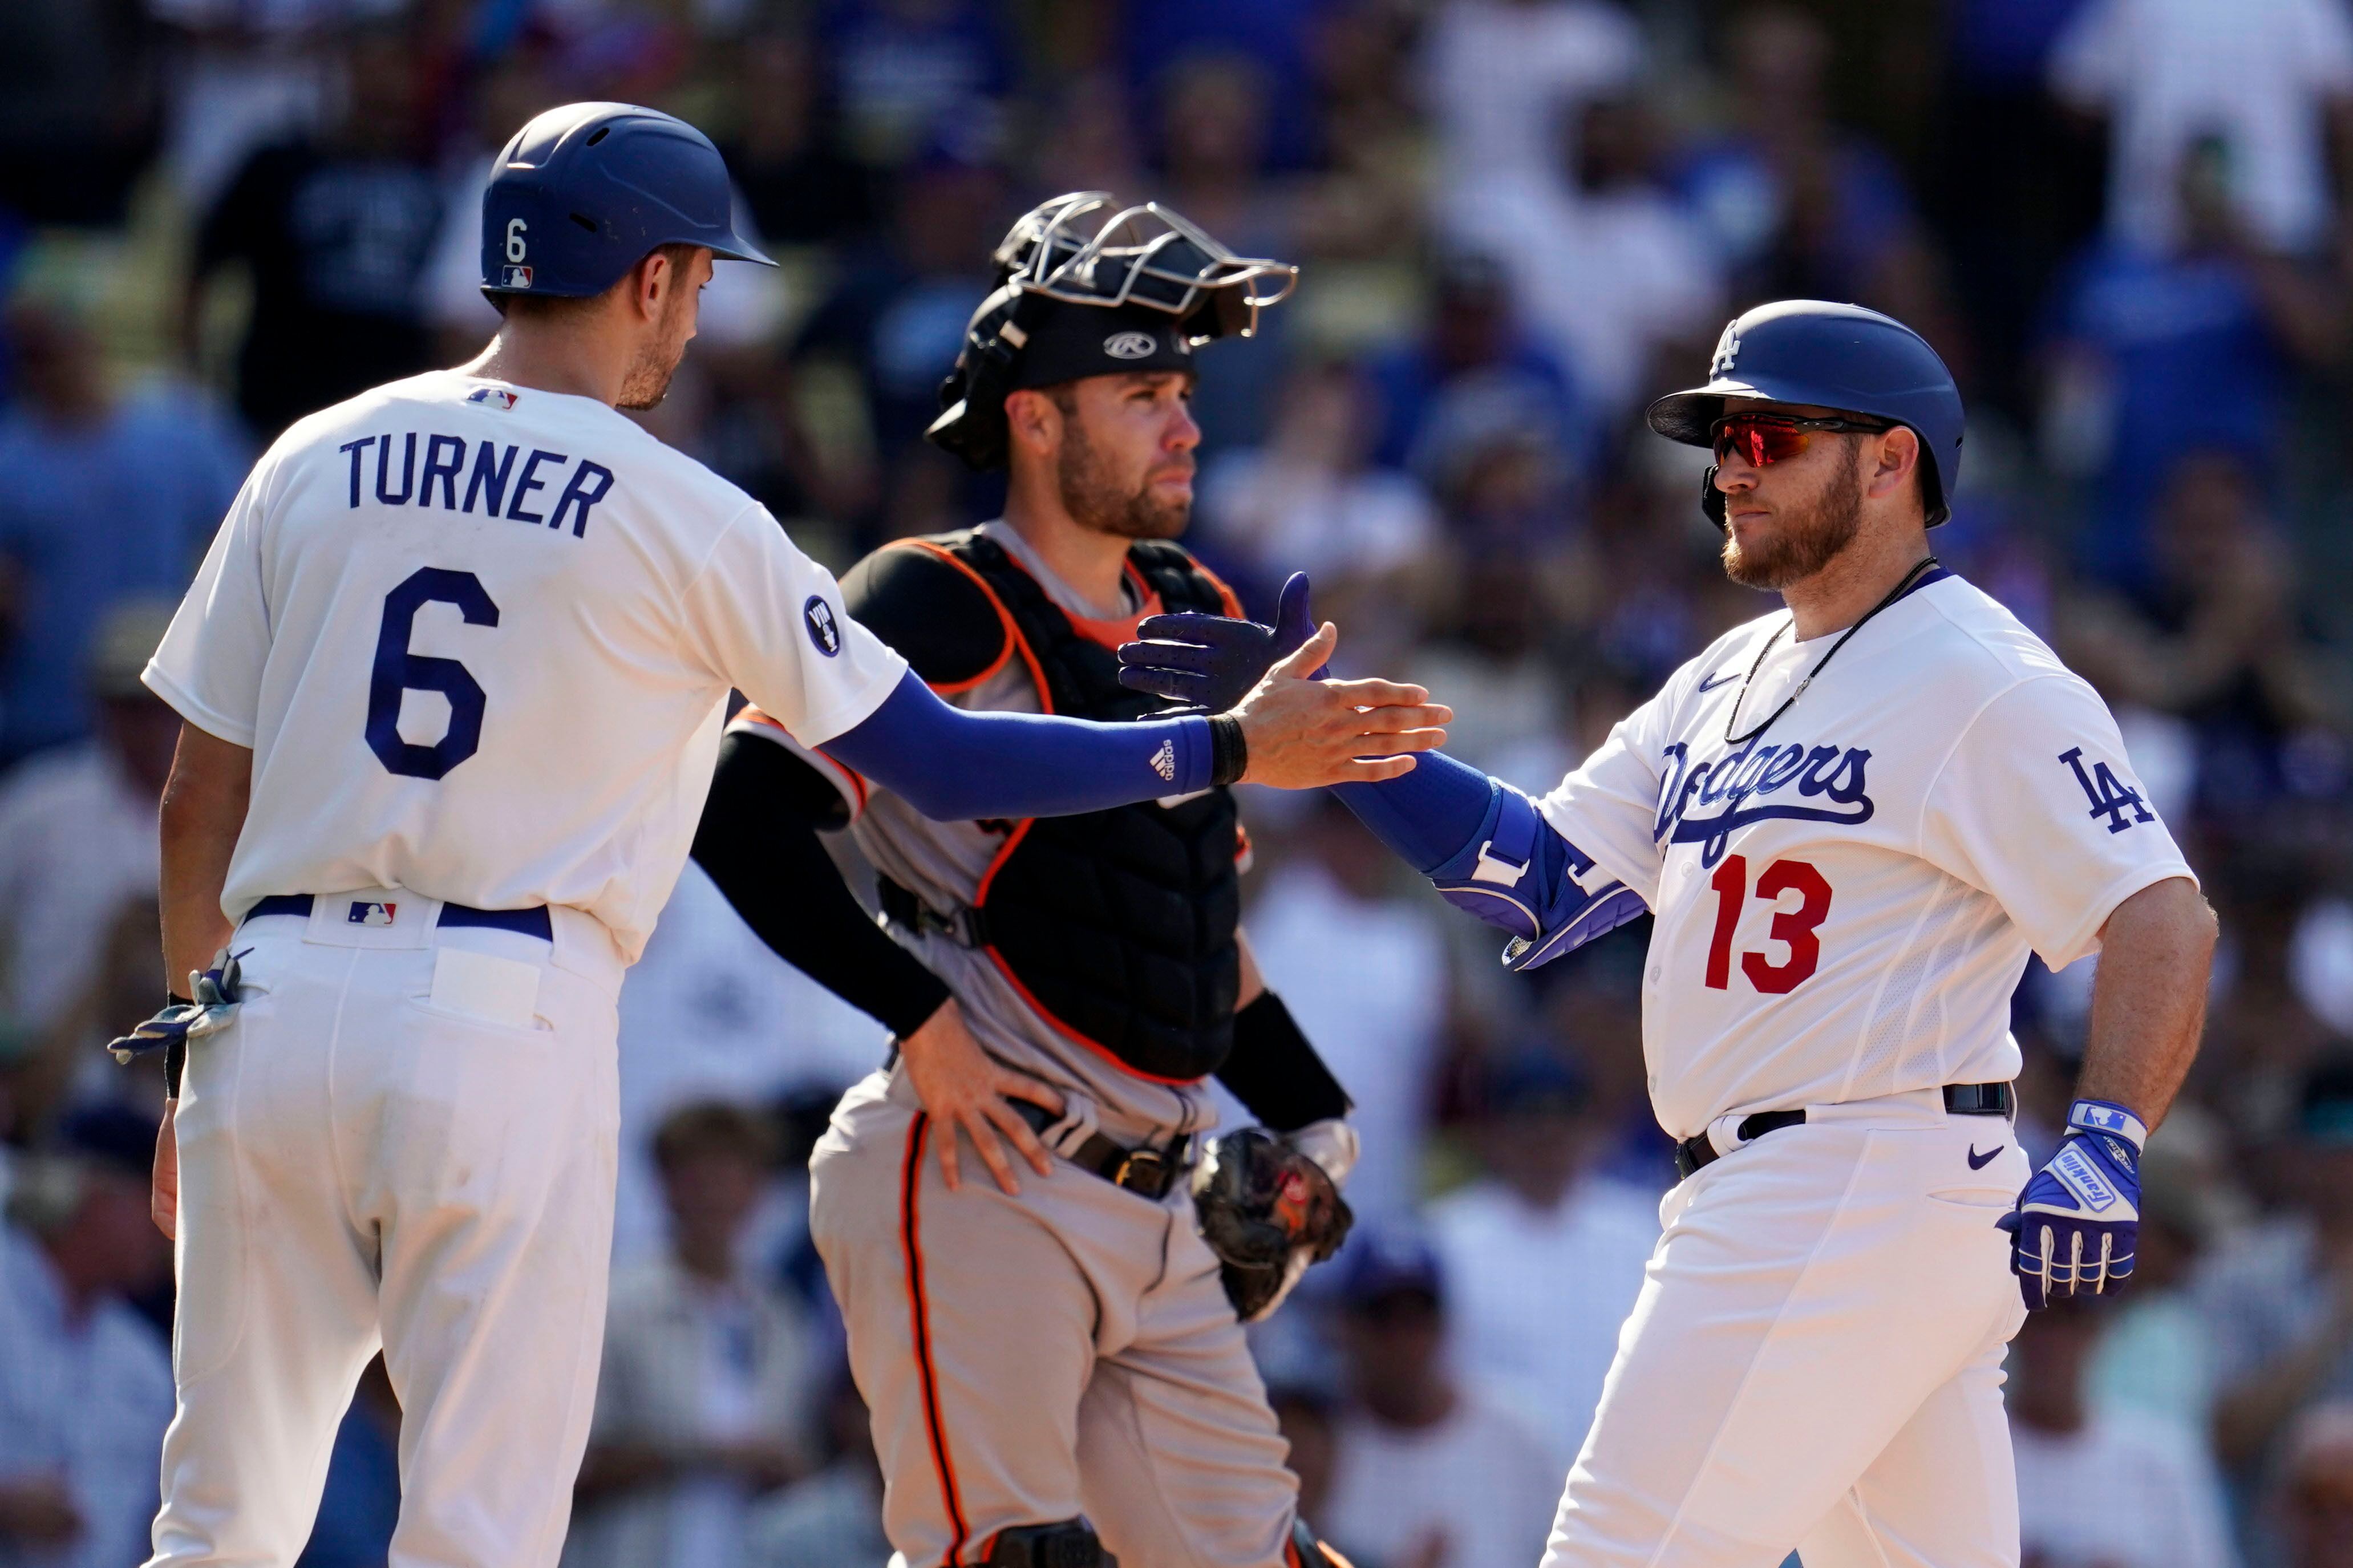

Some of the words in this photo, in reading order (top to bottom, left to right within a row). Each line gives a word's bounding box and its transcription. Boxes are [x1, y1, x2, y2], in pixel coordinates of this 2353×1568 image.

[506, 218, 527, 262] 6
[339, 432, 614, 538] TURNER
[365, 566, 500, 780] 6
[1163, 739, 1175, 781] adidas
[1654, 729, 1874, 869] Dodgers
[2058, 747, 2155, 834] LA
[1705, 854, 1832, 994] 13
[2062, 1154, 2111, 1202] Franklin
